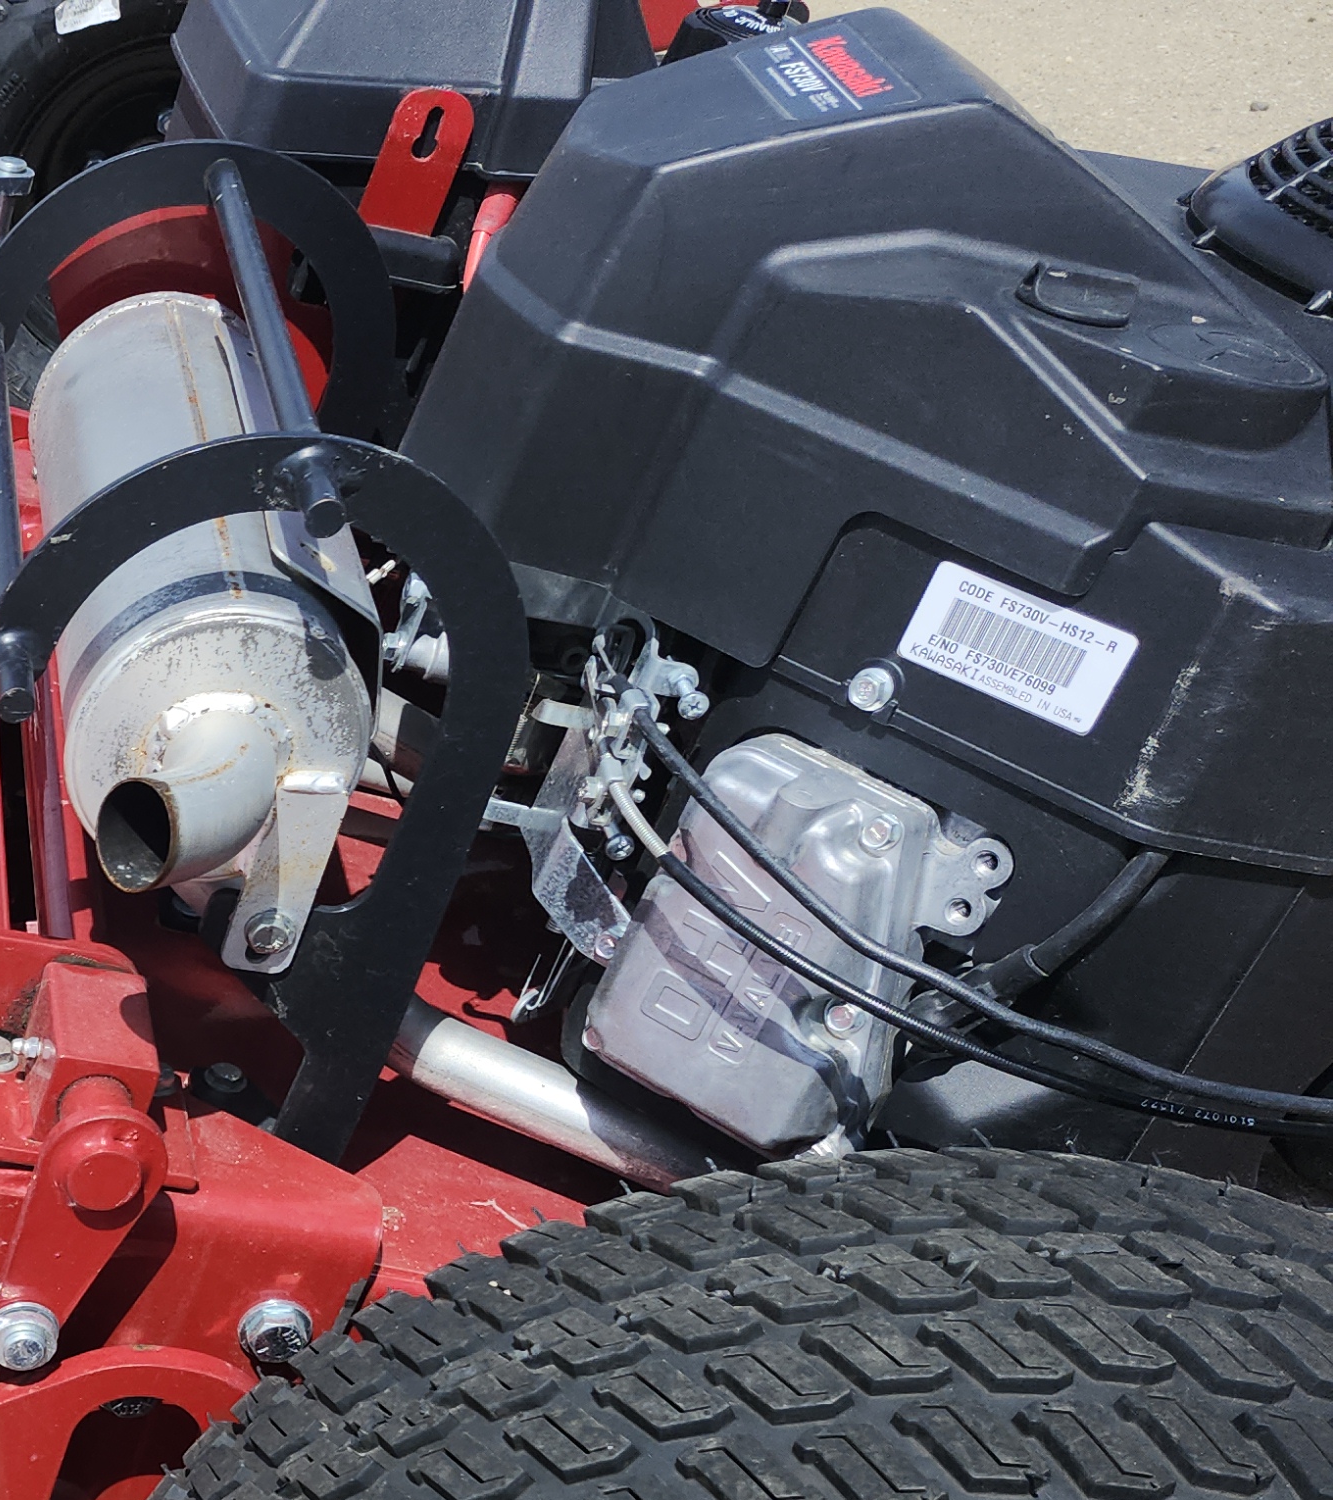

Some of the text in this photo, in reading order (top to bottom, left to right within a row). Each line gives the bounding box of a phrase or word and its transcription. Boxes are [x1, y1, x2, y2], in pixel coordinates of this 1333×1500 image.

[959, 580, 995, 603] CODE
[910, 642, 1072, 721] KAWASAKI ASSEMBLED IN USA
[927, 634, 1056, 696] E/NO FS730VE76099
